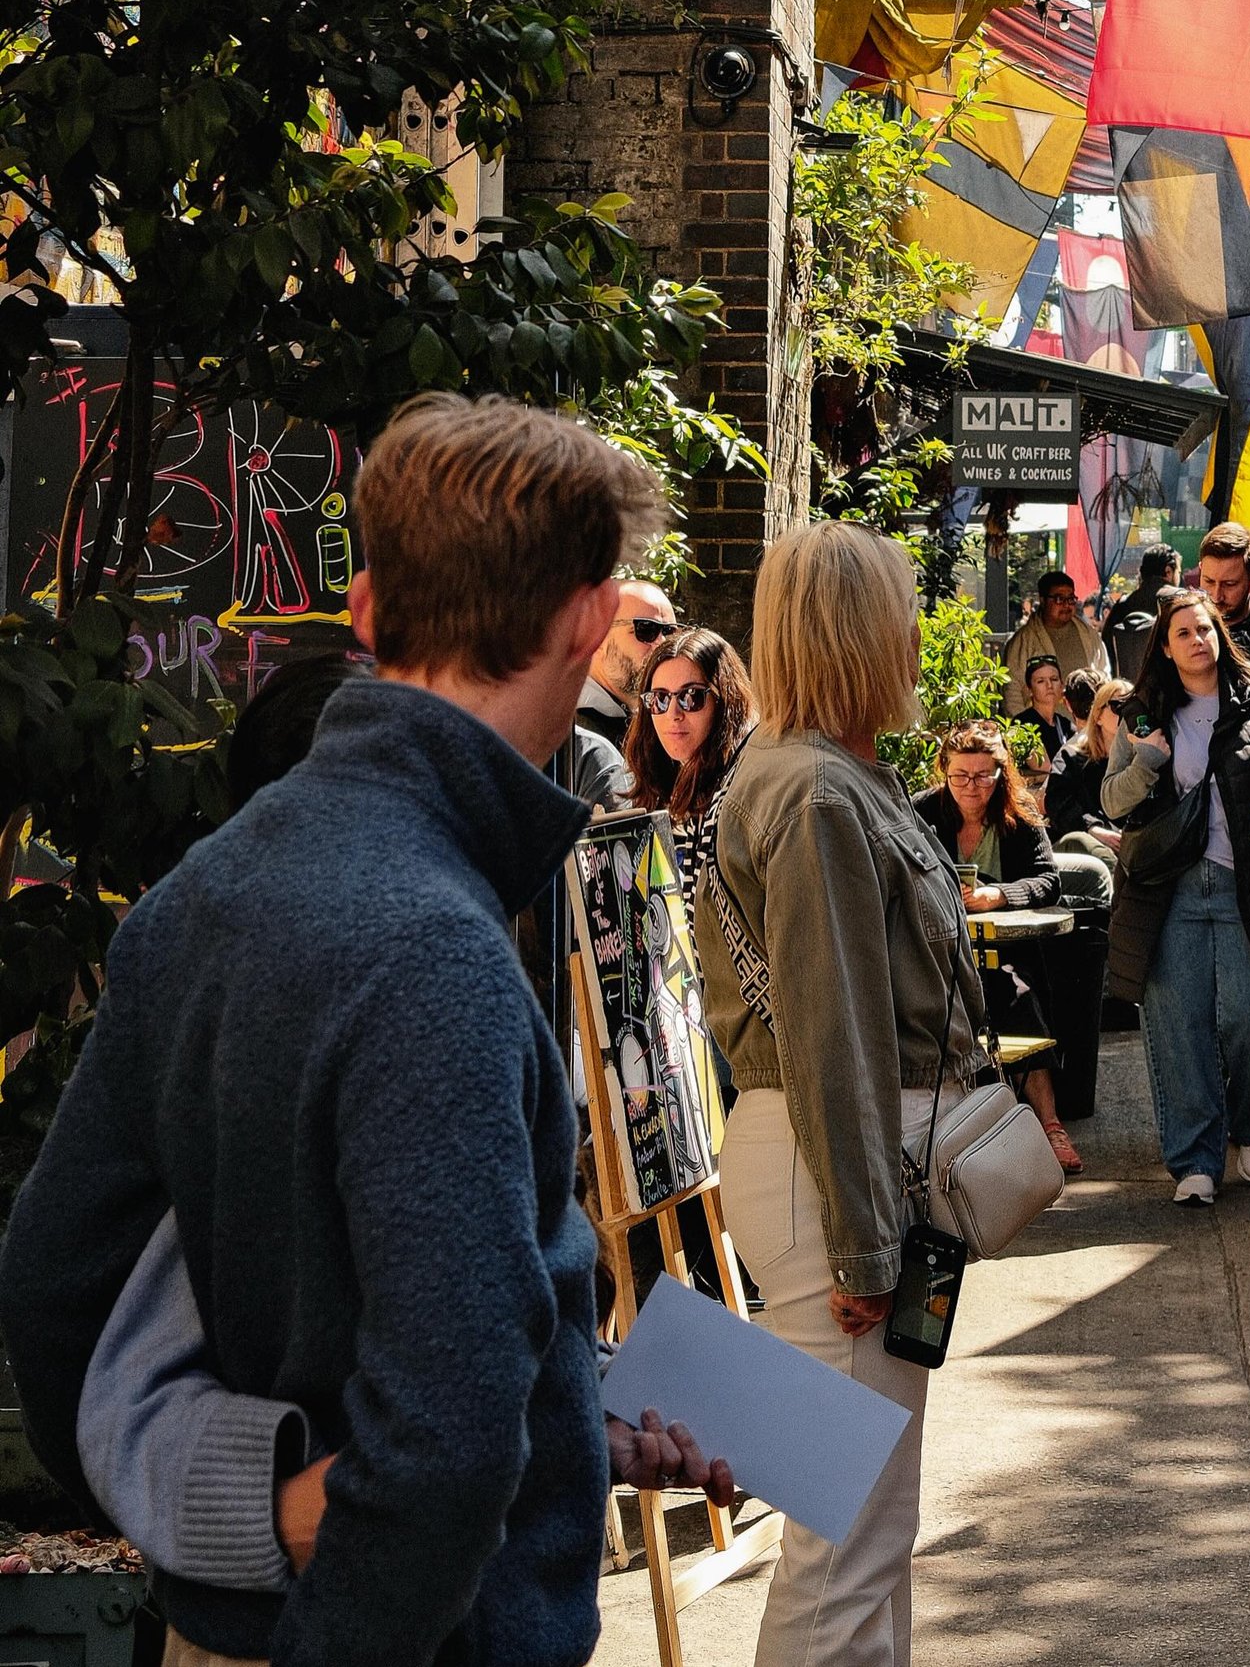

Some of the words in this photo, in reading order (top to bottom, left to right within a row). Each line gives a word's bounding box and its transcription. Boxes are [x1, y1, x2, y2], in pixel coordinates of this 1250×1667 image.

[961, 447, 982, 459] ALL
[987, 443, 1008, 461] UK
[1011, 446, 1046, 461] CRAFT
[1048, 446, 1072, 461] BEER
[963, 466, 1002, 481] WINES
[1008, 467, 1016, 480] &
[1021, 467, 1072, 481] COCKTAILS
